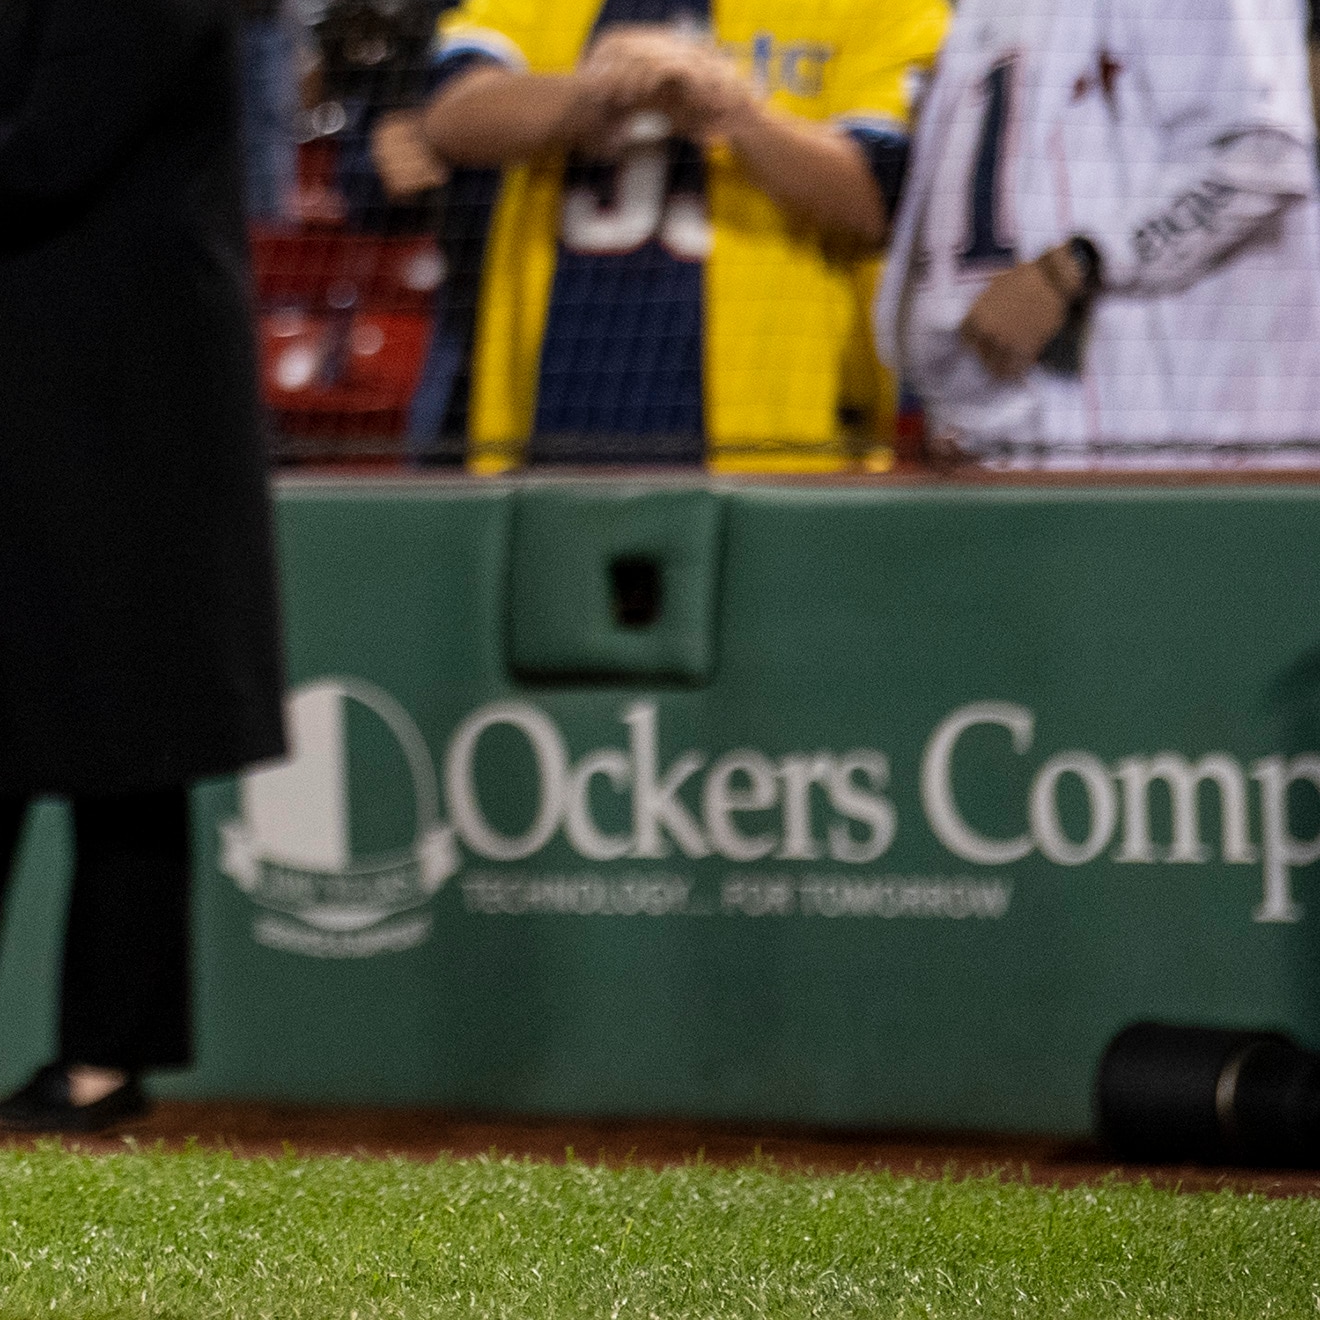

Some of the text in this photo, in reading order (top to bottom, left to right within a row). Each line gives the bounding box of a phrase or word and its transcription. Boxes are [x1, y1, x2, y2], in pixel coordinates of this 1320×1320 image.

[444, 700, 1320, 923] Ockers Comp
[721, 874, 792, 917] FOR
[798, 875, 1012, 919] TOMORROW
